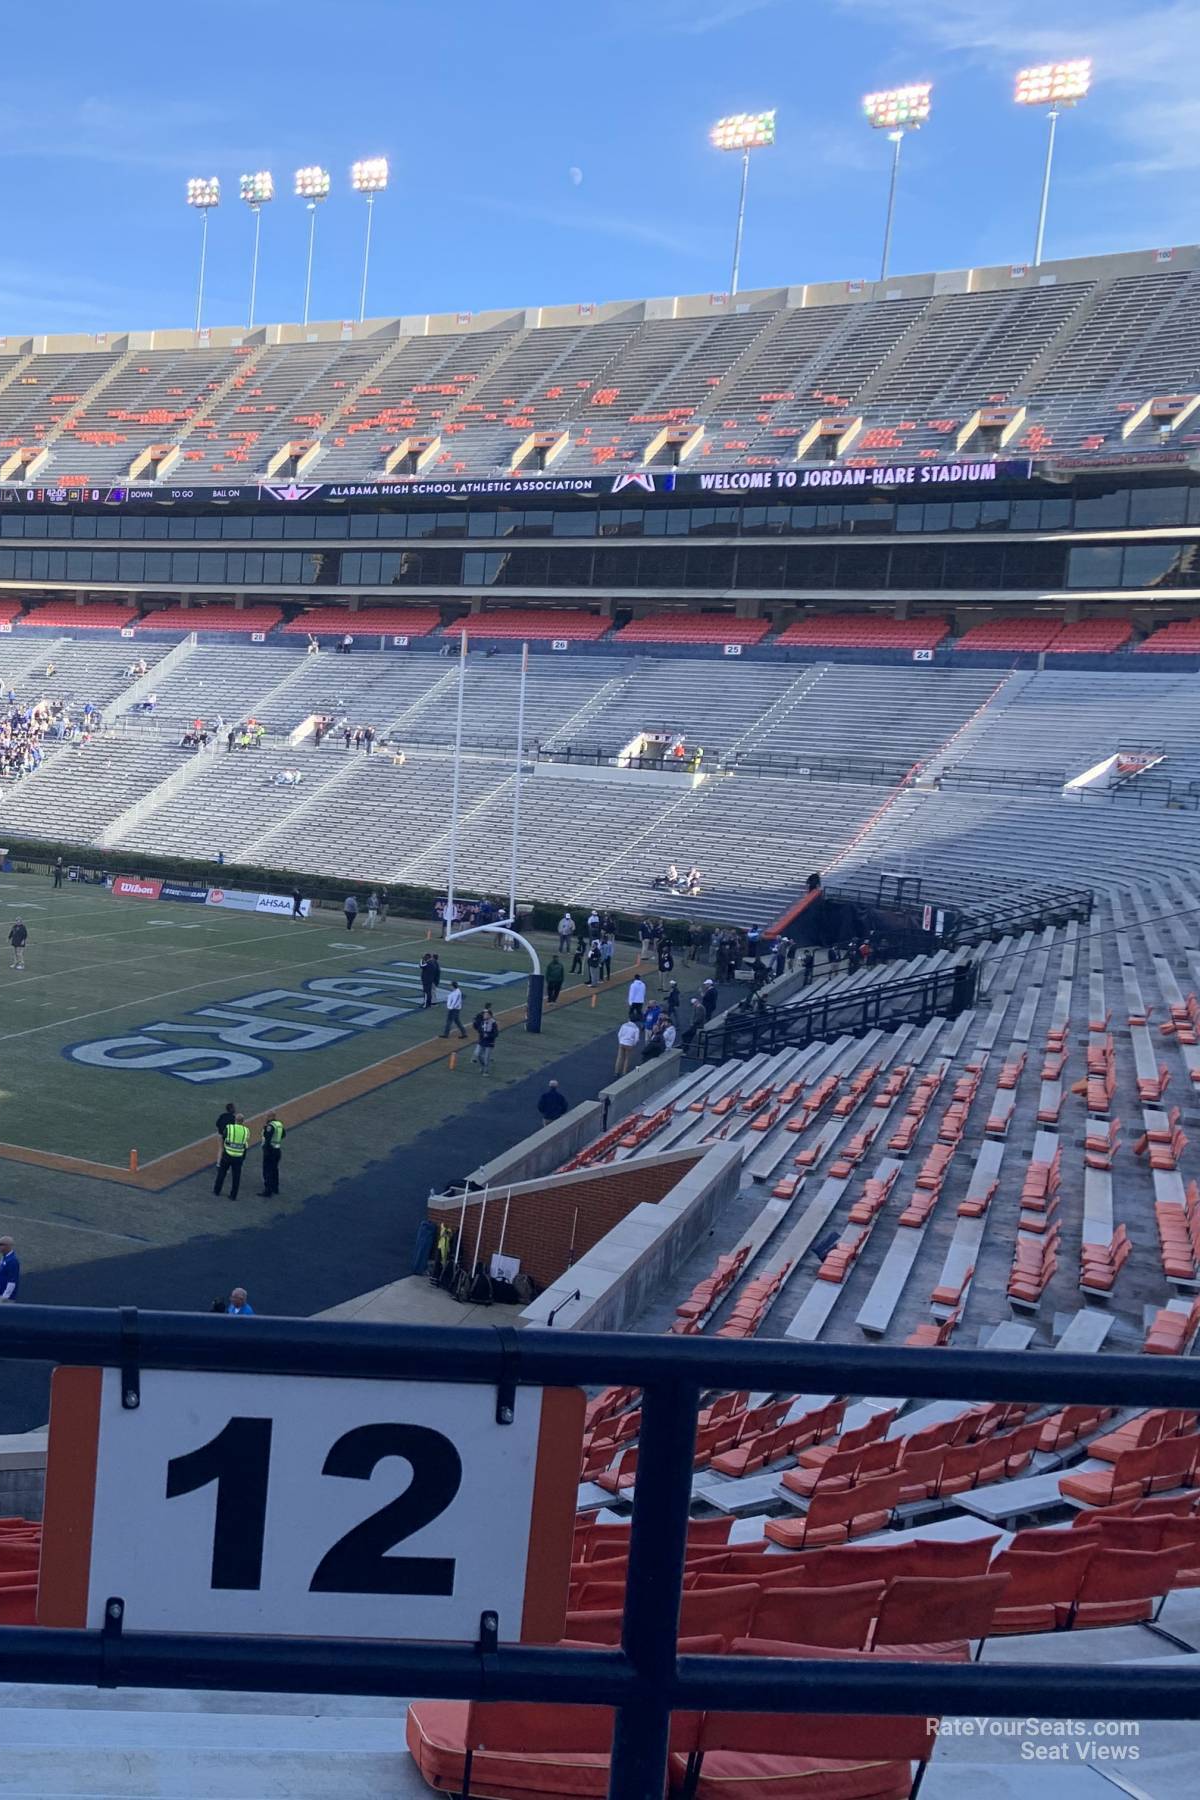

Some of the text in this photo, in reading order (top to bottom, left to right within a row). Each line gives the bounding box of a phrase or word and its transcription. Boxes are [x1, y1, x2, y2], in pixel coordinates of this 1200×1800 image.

[700, 463, 996, 490] WELCOME TO JORDAN-HARE STADIUM
[212, 489, 240, 497] BALL ON
[330, 480, 593, 496] ALABAMA HIGH SCHOOL ATHLETIC ASSOCIATION
[131, 490, 153, 498] DOWN
[172, 490, 193, 498] TO GO
[727, 646, 739, 654] 25
[916, 651, 930, 660] 24
[120, 882, 153, 894] Wilson
[259, 898, 291, 909] AHSAA
[62, 960, 532, 1084] TIGERS
[166, 1416, 463, 1597] 12
